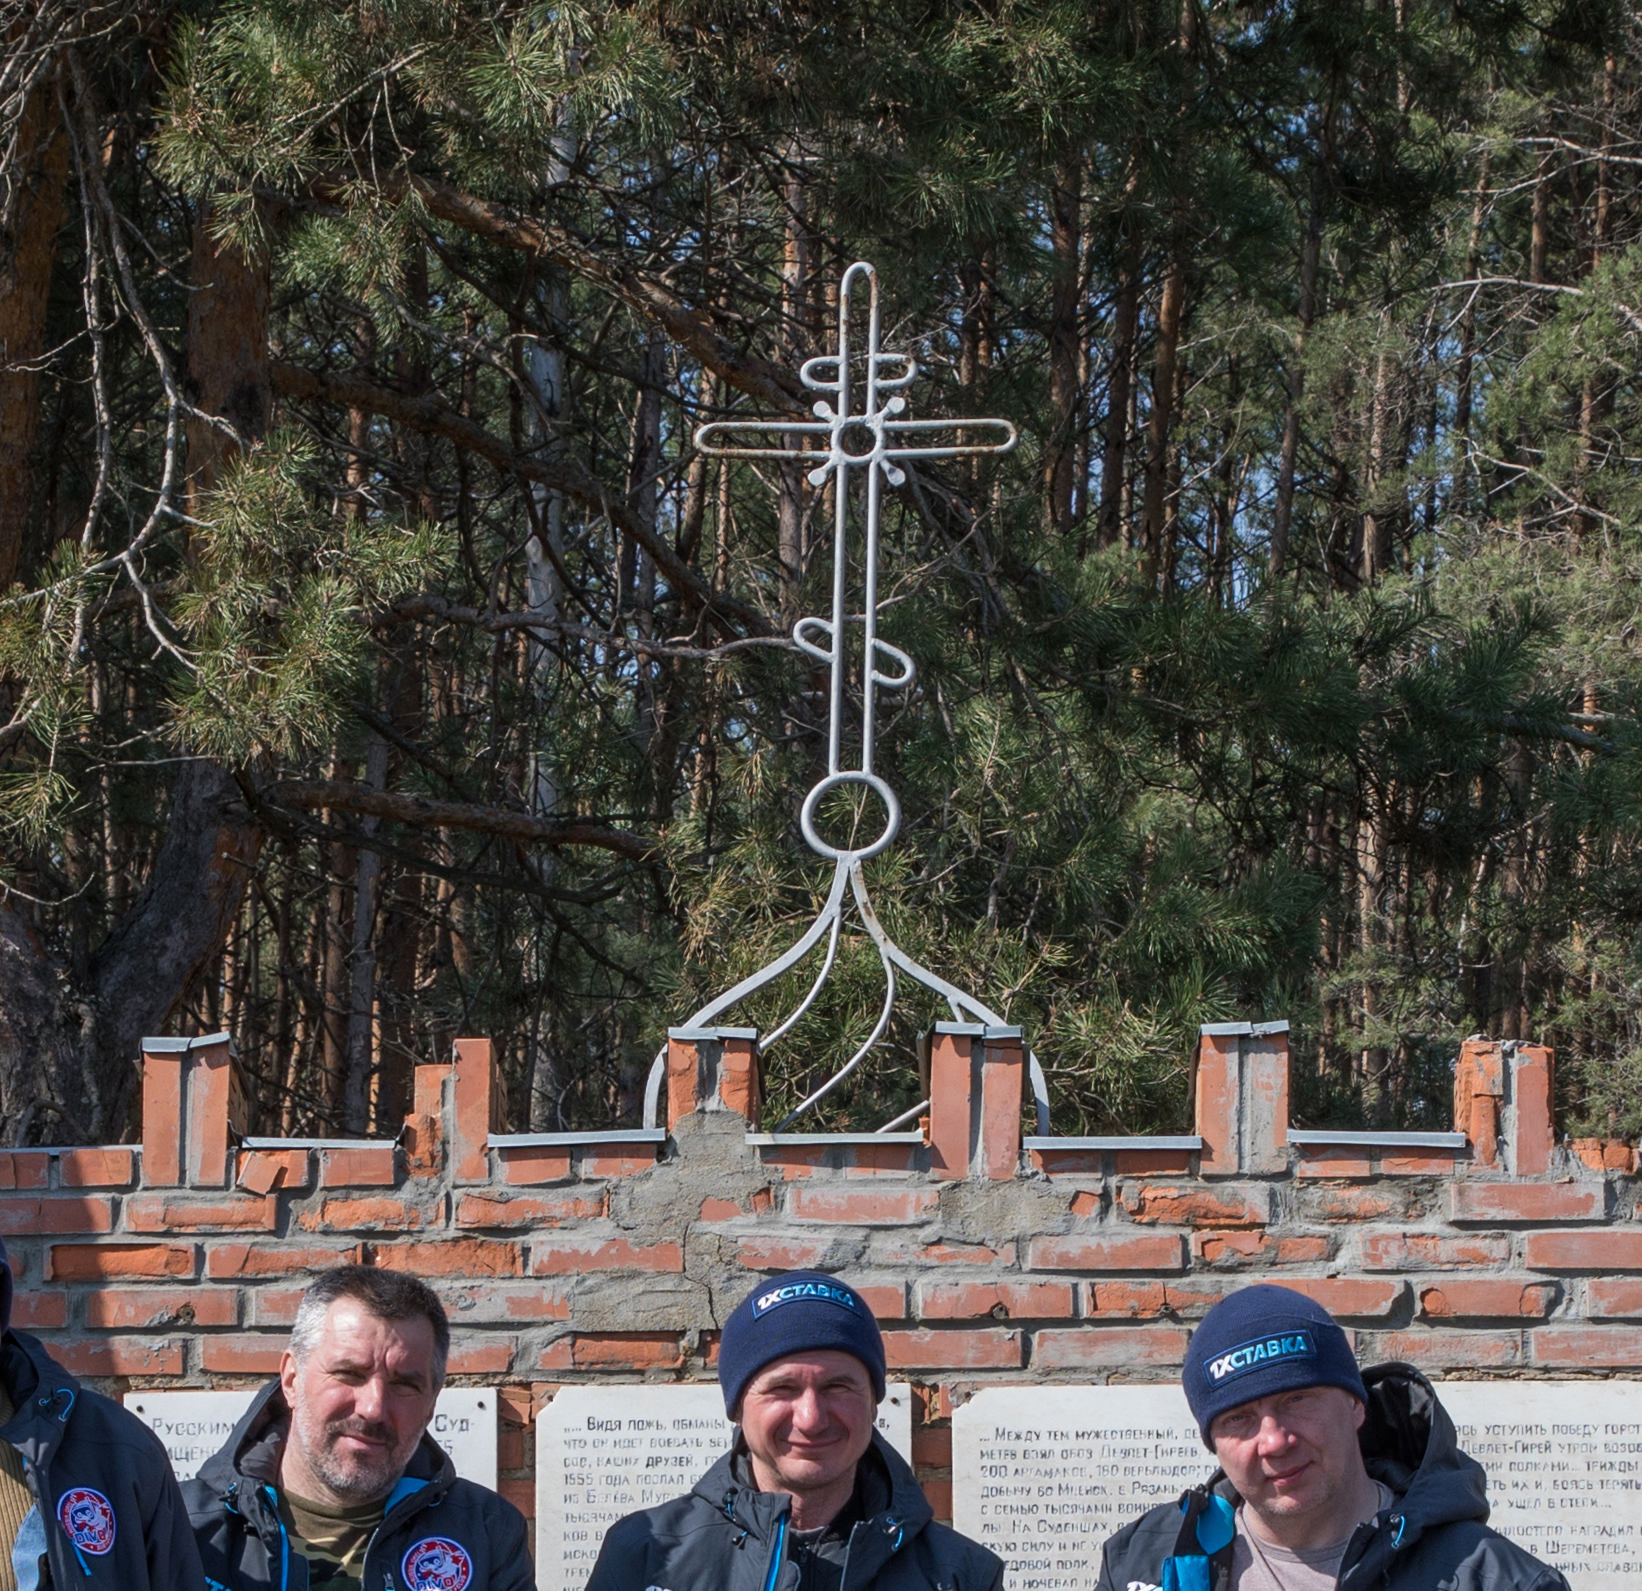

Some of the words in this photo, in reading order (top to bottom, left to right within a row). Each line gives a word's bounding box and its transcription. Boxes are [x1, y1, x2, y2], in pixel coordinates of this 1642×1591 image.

[1047, 1430, 1070, 1440] ТЕМ
[1484, 1425, 1547, 1436] УСТУПИТЬ
[1553, 1425, 1600, 1438] ПОБЕДУ
[980, 1465, 1008, 1478] 200
[1587, 1461, 1639, 1473] ТРИЖДЫ
[1600, 1479, 1642, 1490] ТЕРЯТЬ
[995, 1504, 1039, 1514] СЕМЬЮ
[1044, 1503, 1113, 1514] ТЫСЯЧАМИ
[1012, 1520, 1031, 1532] НА
[1570, 1525, 1633, 1537] НАГРАДИЛ
[1072, 1541, 1086, 1551] НЕ
